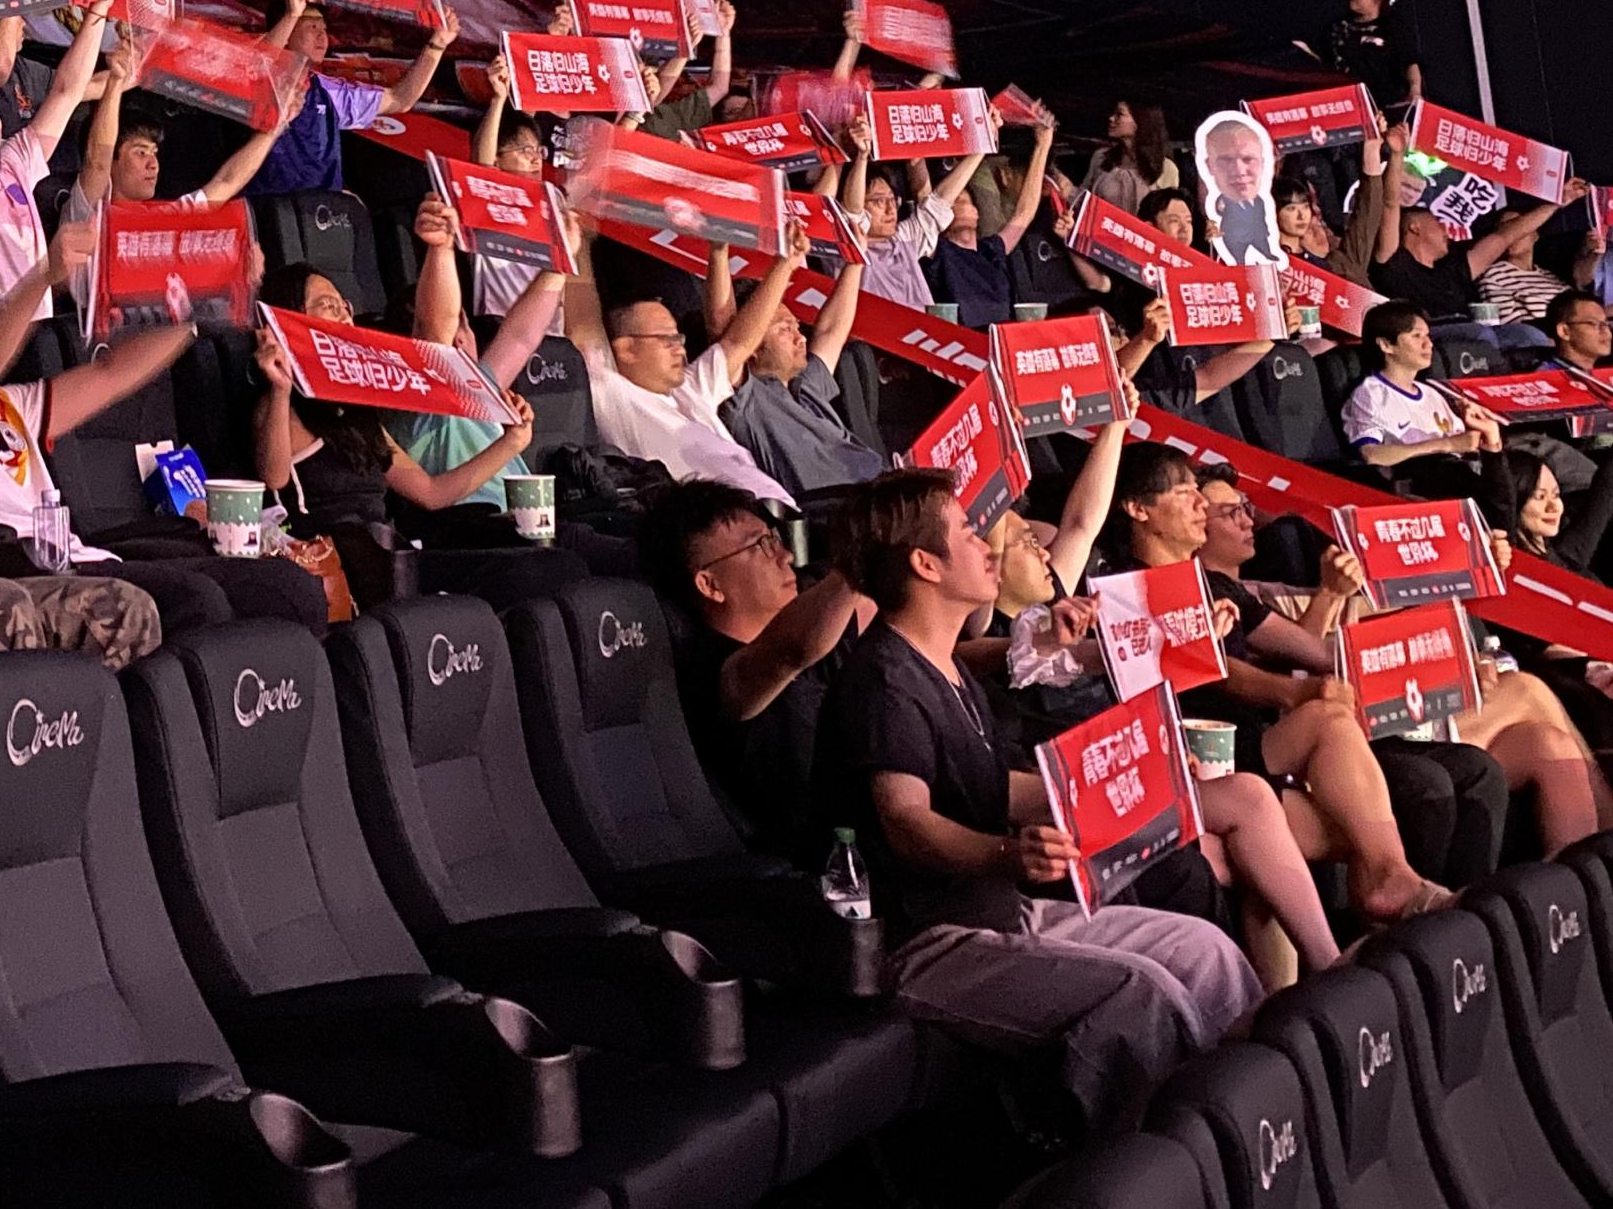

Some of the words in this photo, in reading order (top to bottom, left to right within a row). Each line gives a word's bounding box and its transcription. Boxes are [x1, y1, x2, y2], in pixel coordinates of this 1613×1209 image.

[1435, 134, 1507, 173] 足球归少年
[1438, 118, 1509, 157] 日落归山海
[320, 356, 432, 396] 足球归少年
[1397, 541, 1439, 566] 世界杯
